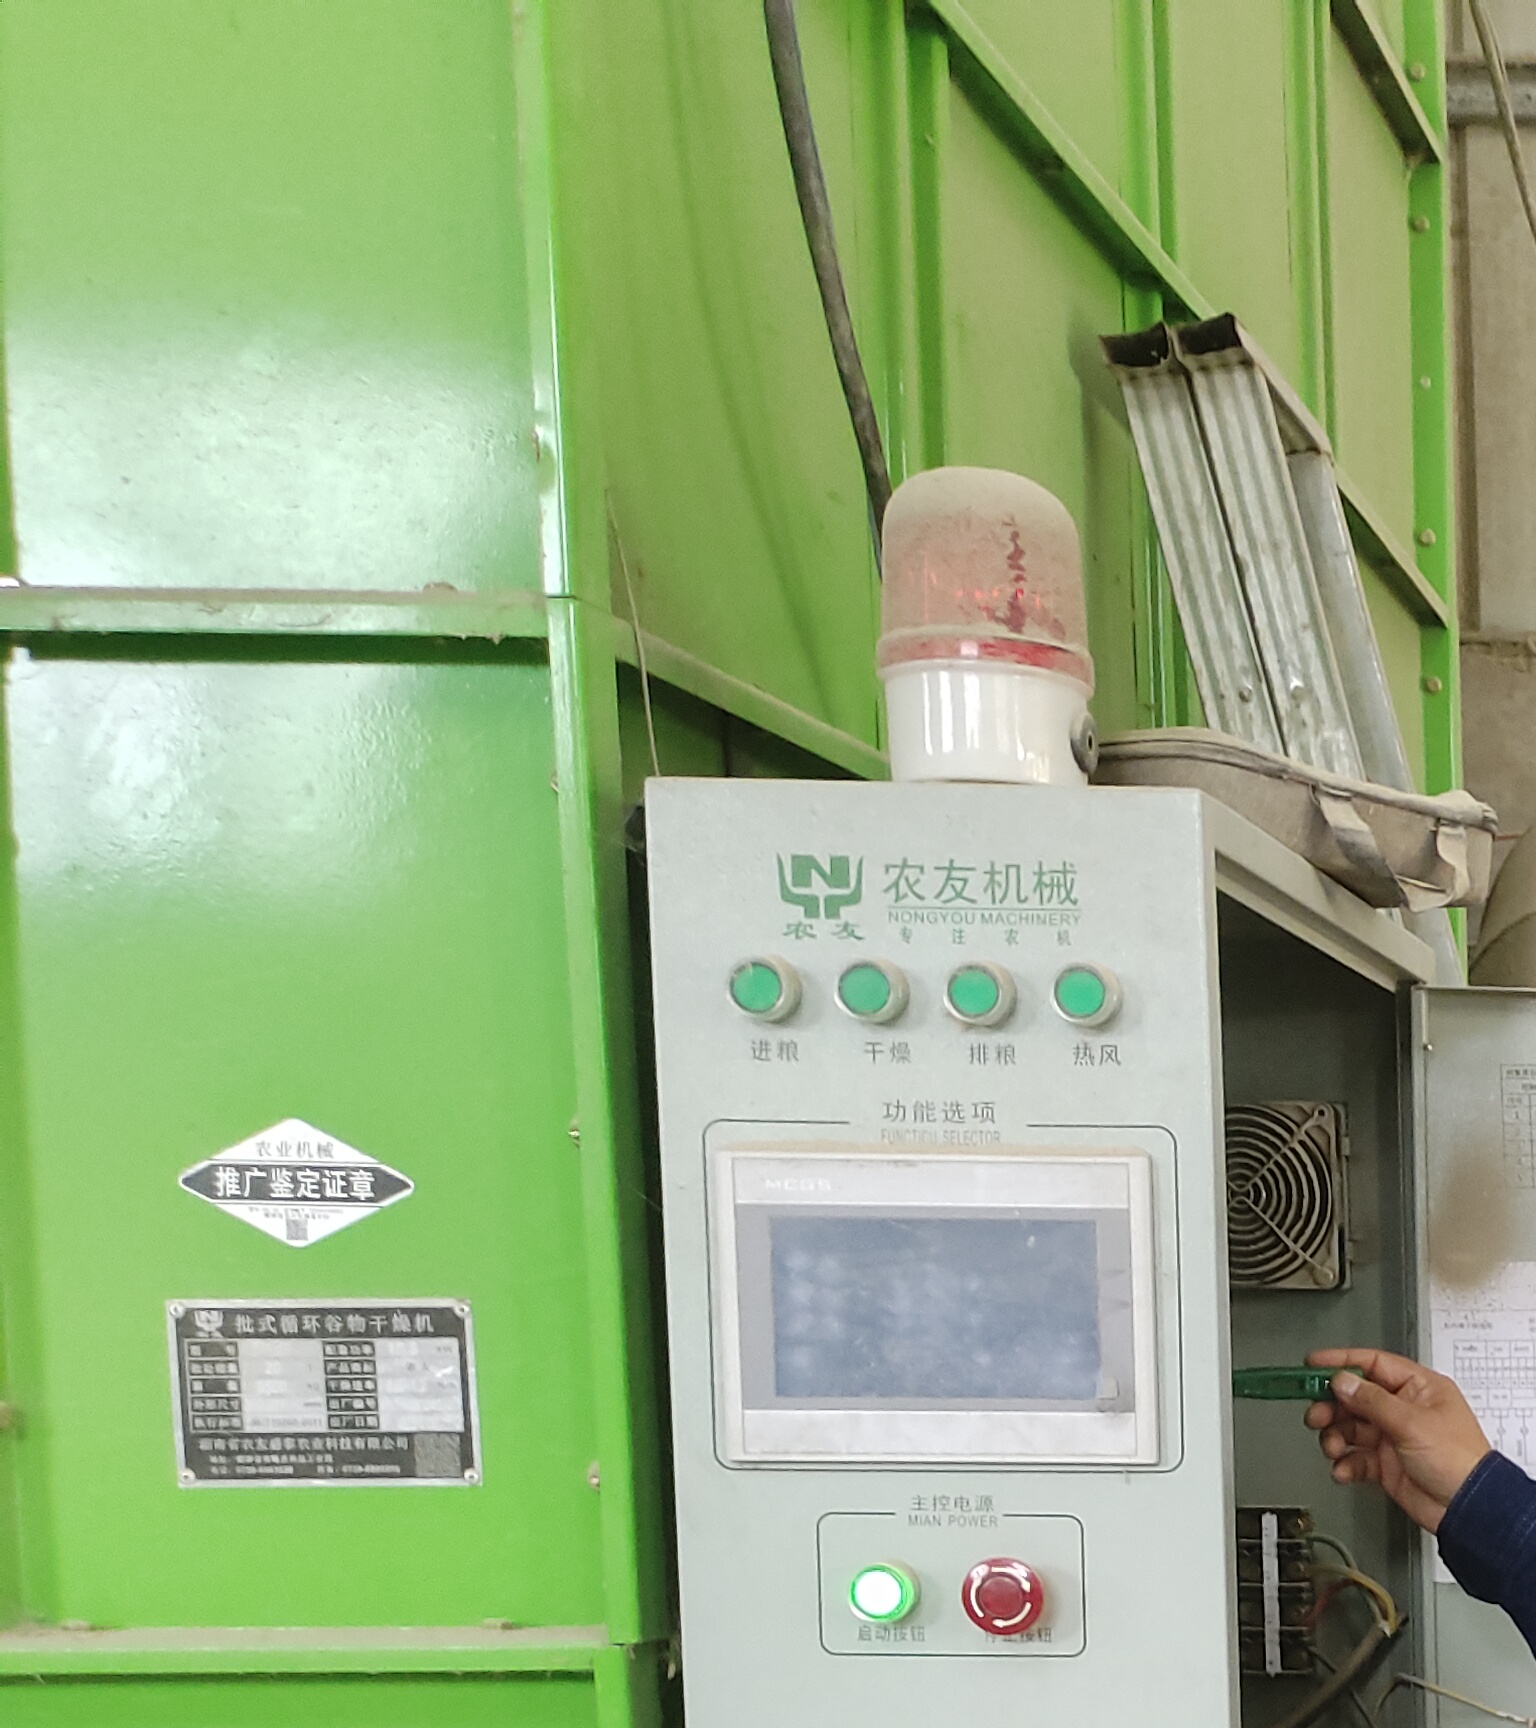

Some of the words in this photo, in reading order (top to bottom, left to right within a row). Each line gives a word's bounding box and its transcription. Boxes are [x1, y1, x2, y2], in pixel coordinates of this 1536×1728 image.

[883, 857, 1080, 906] 农友机械
[888, 910, 975, 924] NONGYOU
[980, 911, 1081, 926] MACHINERY
[782, 921, 866, 941] 农友
[750, 1040, 800, 1062] 进粮
[863, 1041, 912, 1065] 干燥
[968, 1043, 1017, 1067] 排粮
[1072, 1043, 1122, 1067] 热风
[882, 1101, 997, 1125] 功能选项
[255, 1141, 335, 1160] 农业机械
[214, 1166, 377, 1200] 推广鉴定证章
[911, 1495, 995, 1512] 主控电源
[908, 1515, 942, 1528] MIAN
[948, 1515, 998, 1528] POWER
[858, 1625, 926, 1643] 启动按钮
